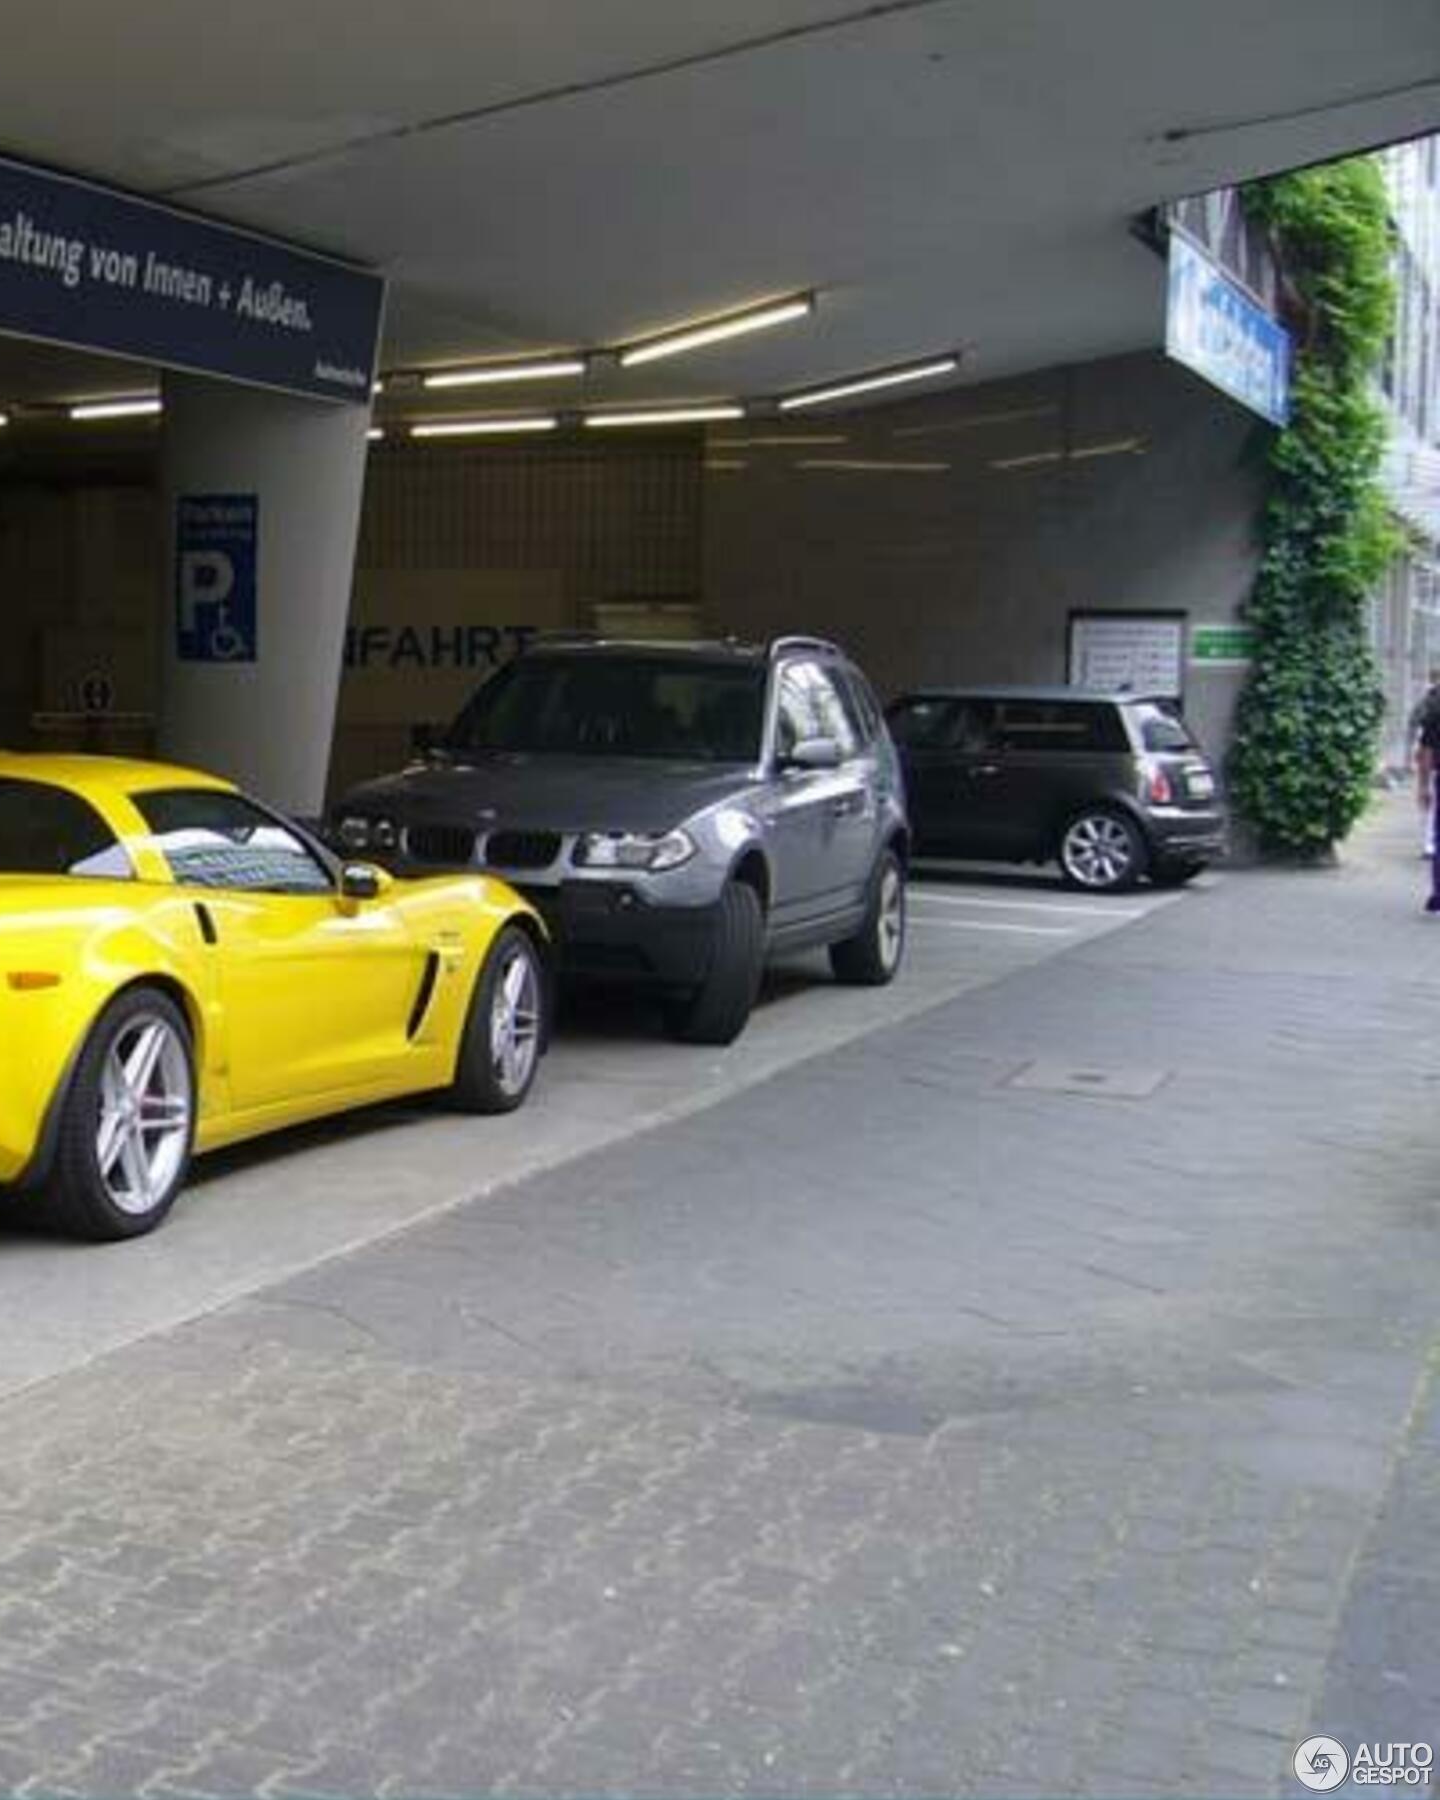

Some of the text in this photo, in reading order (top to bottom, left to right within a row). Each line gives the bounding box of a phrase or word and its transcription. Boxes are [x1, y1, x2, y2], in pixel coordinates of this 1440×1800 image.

[89, 247, 138, 288] von
[143, 251, 212, 305] Innen
[236, 278, 314, 331] Außen.
[181, 549, 235, 631] P
